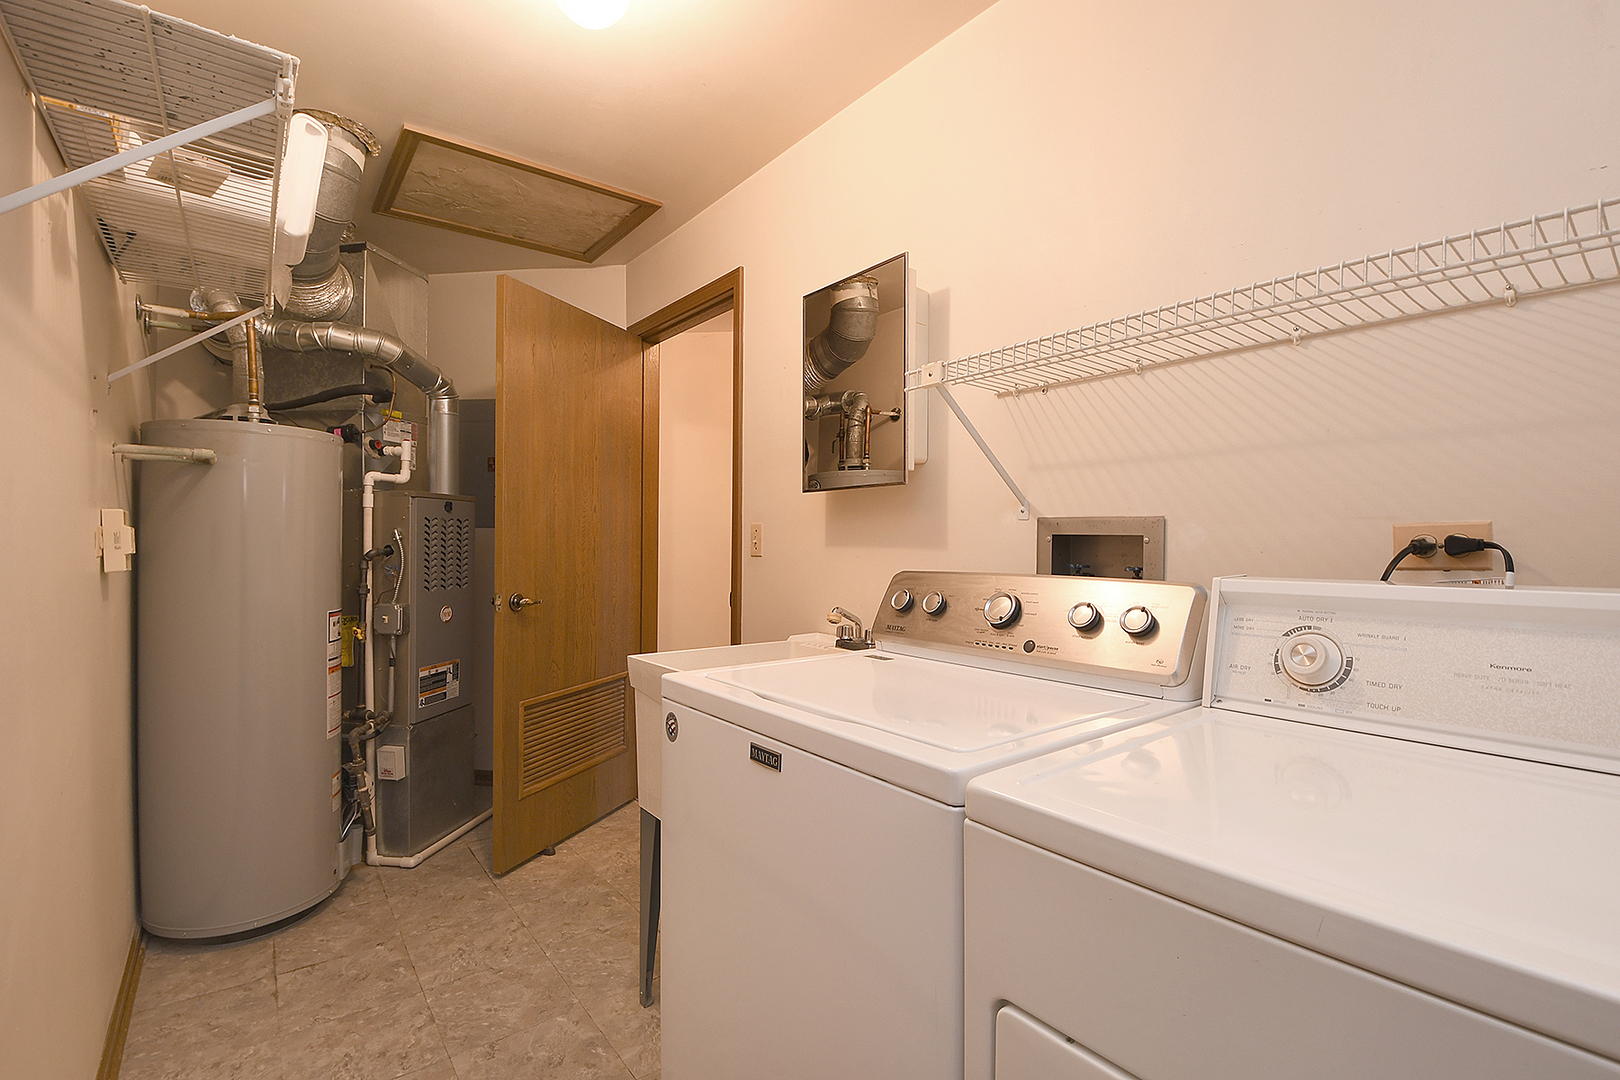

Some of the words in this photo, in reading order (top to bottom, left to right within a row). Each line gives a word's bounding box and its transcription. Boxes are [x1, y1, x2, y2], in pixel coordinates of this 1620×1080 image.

[1489, 663, 1532, 672] Kenmore
[1366, 702, 1389, 710] TOUCH
[752, 748, 778, 766] MAYTAG
